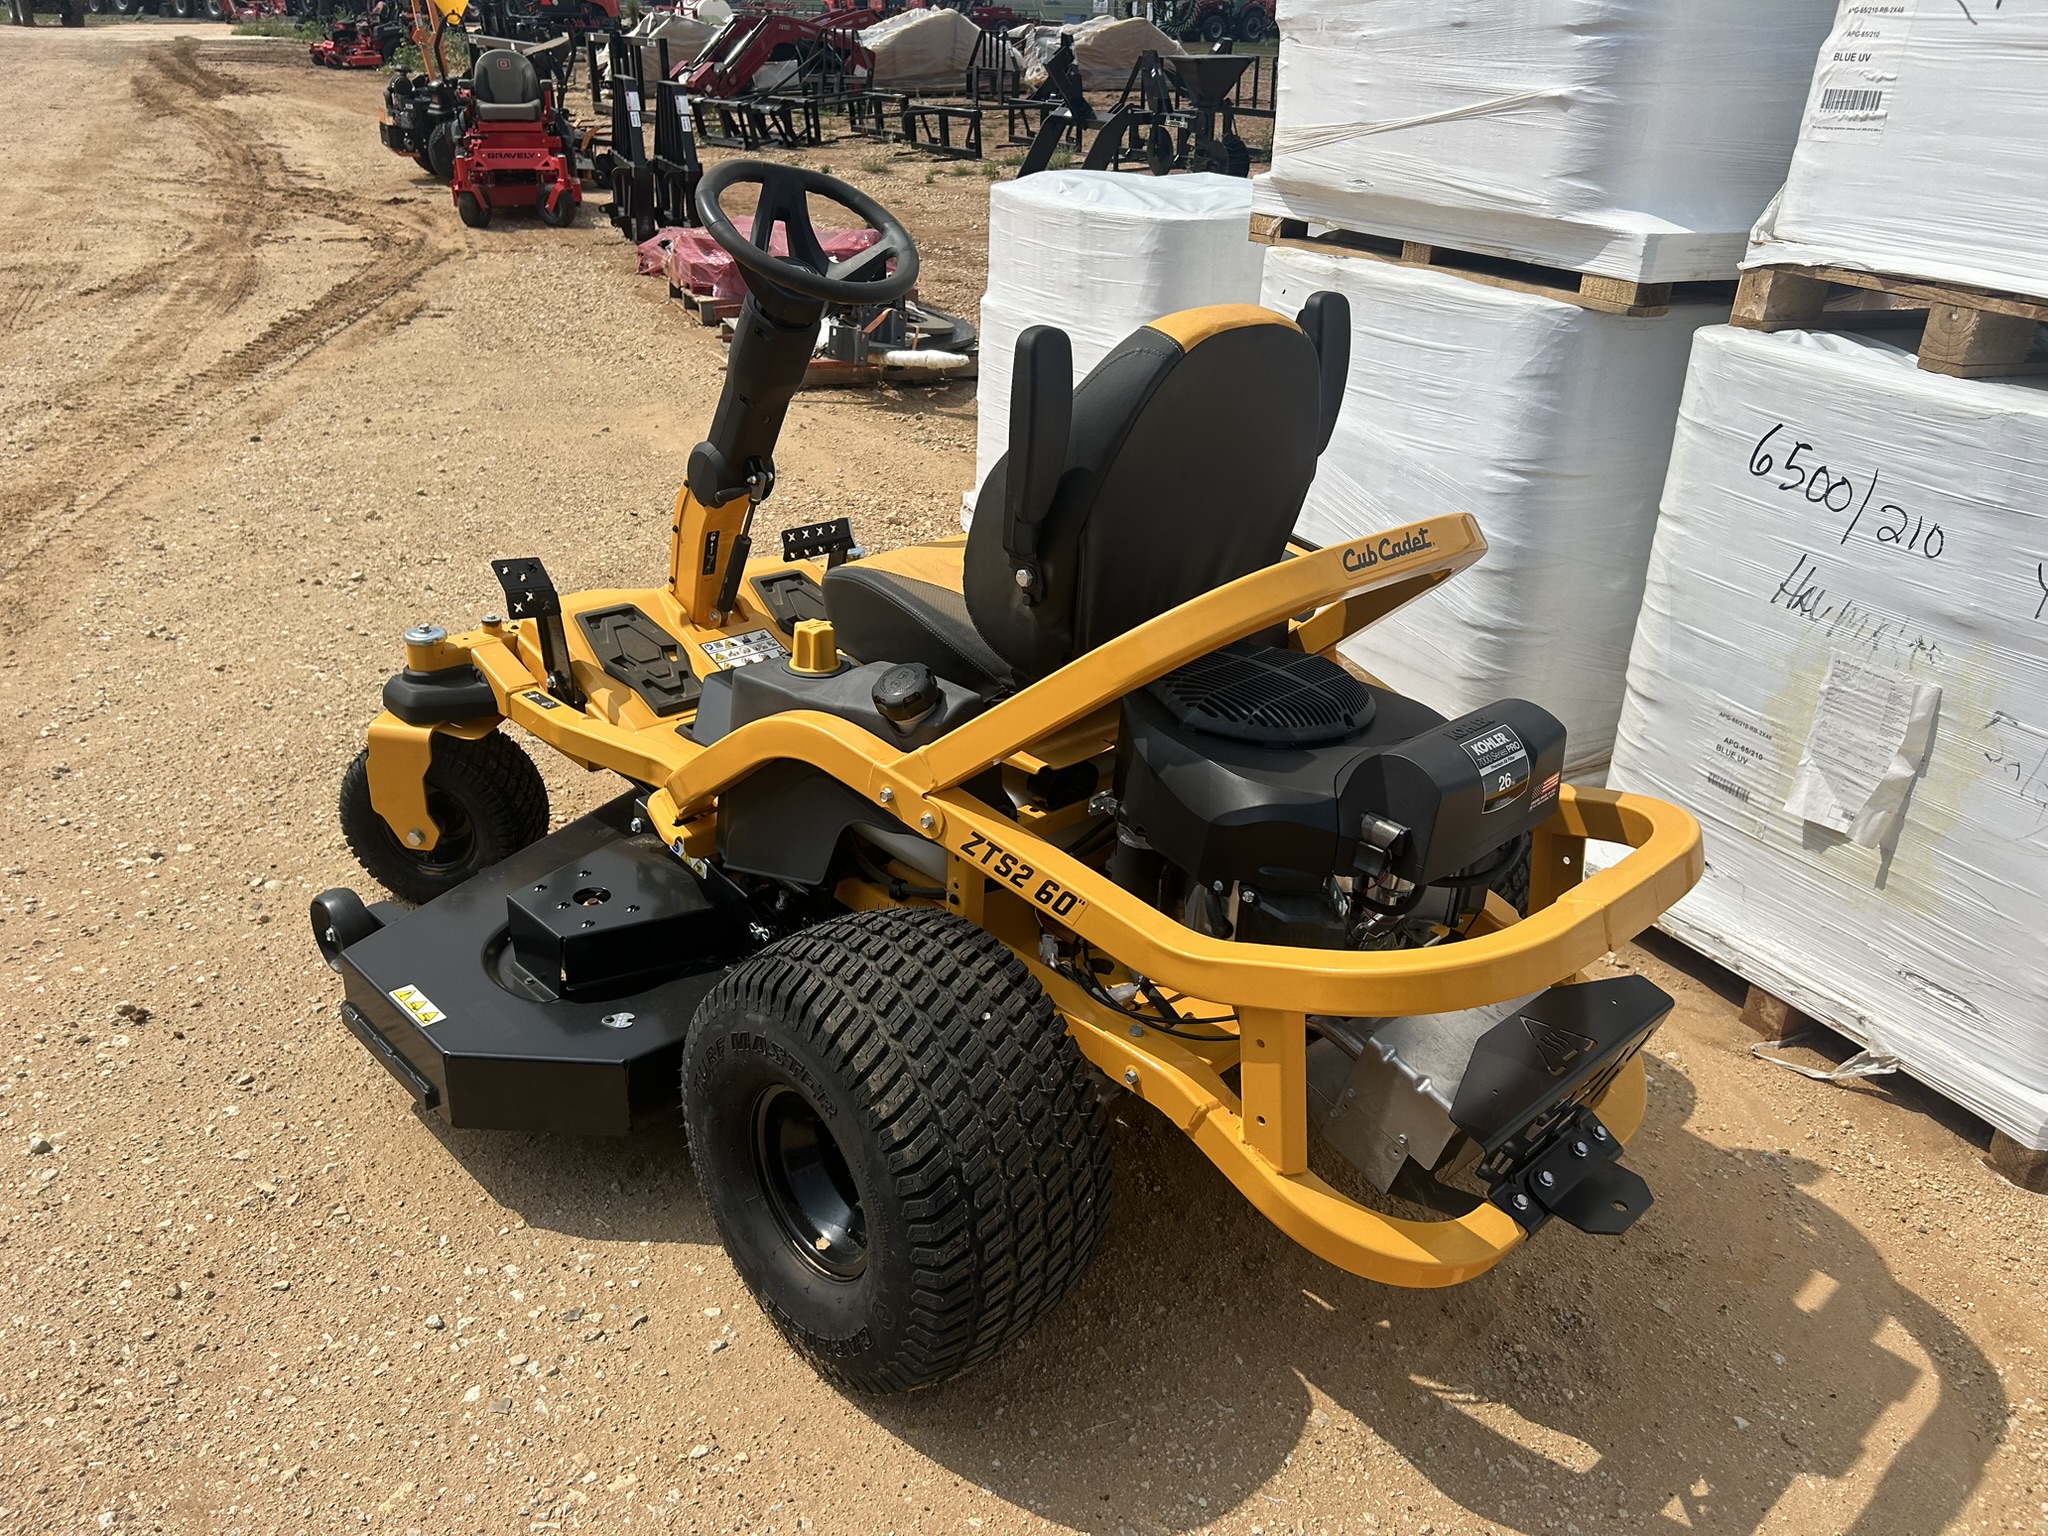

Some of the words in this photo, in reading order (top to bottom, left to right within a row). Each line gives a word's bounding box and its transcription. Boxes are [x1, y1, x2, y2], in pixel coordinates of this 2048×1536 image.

[1833, 52, 1857, 62] BLUE
[1858, 53, 1872, 63] UV
[487, 152, 536, 160] GRAVELY
[1749, 423, 1945, 559] 6500/210
[1342, 542, 1378, 572] Cub
[1378, 528, 1432, 562] Cadet
[1470, 732, 1510, 756] KOHLER
[1478, 752, 1493, 767] 7000
[1491, 747, 1508, 761] Series
[1505, 741, 1520, 753] PRO
[1715, 744, 1736, 760] BLUE
[1737, 754, 1749, 764] UV
[1723, 737, 1763, 761] APG-65/210
[1498, 772, 1511, 792] 26
[960, 831, 1035, 889] ZTS2
[1034, 879, 1086, 917] 60"
[693, 1037, 726, 1096] TURF
[730, 1031, 838, 1118] MASTER
